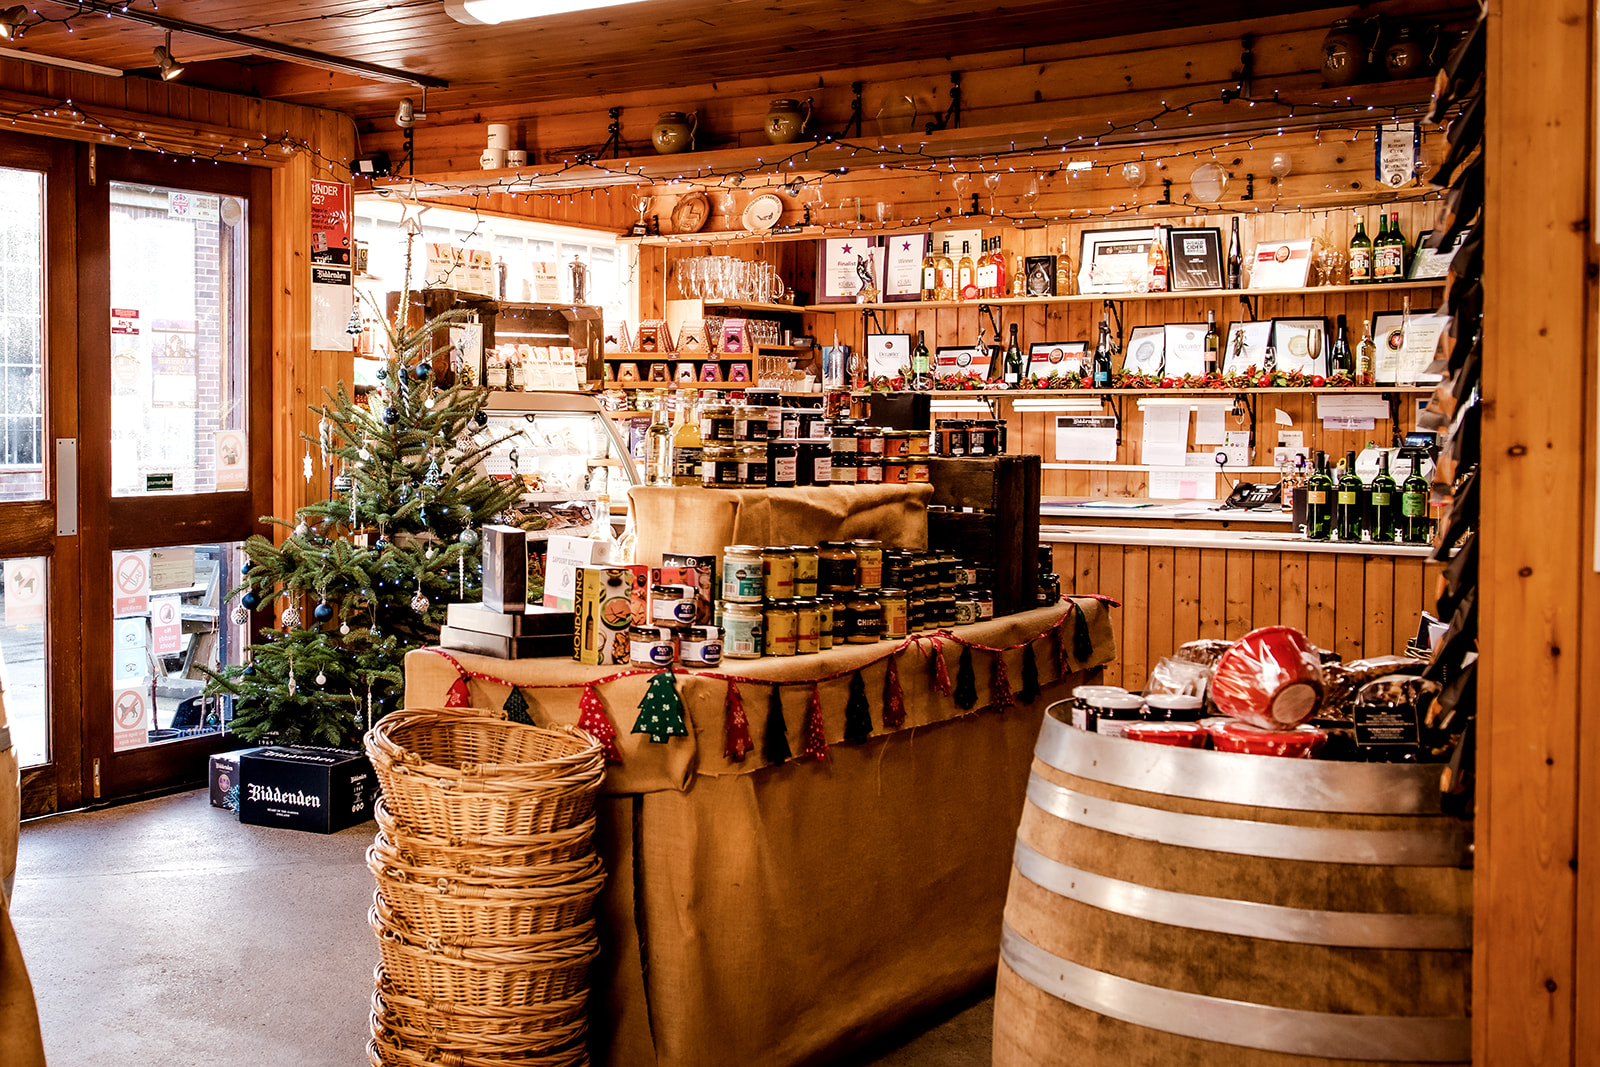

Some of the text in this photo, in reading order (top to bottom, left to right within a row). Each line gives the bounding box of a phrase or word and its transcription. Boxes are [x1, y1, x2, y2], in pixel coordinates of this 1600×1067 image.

[311, 183, 338, 196] UNDER
[311, 194, 325, 205] 25?
[573, 569, 584, 660] MONDOVINO
[247, 782, 321, 808] Biddenden
